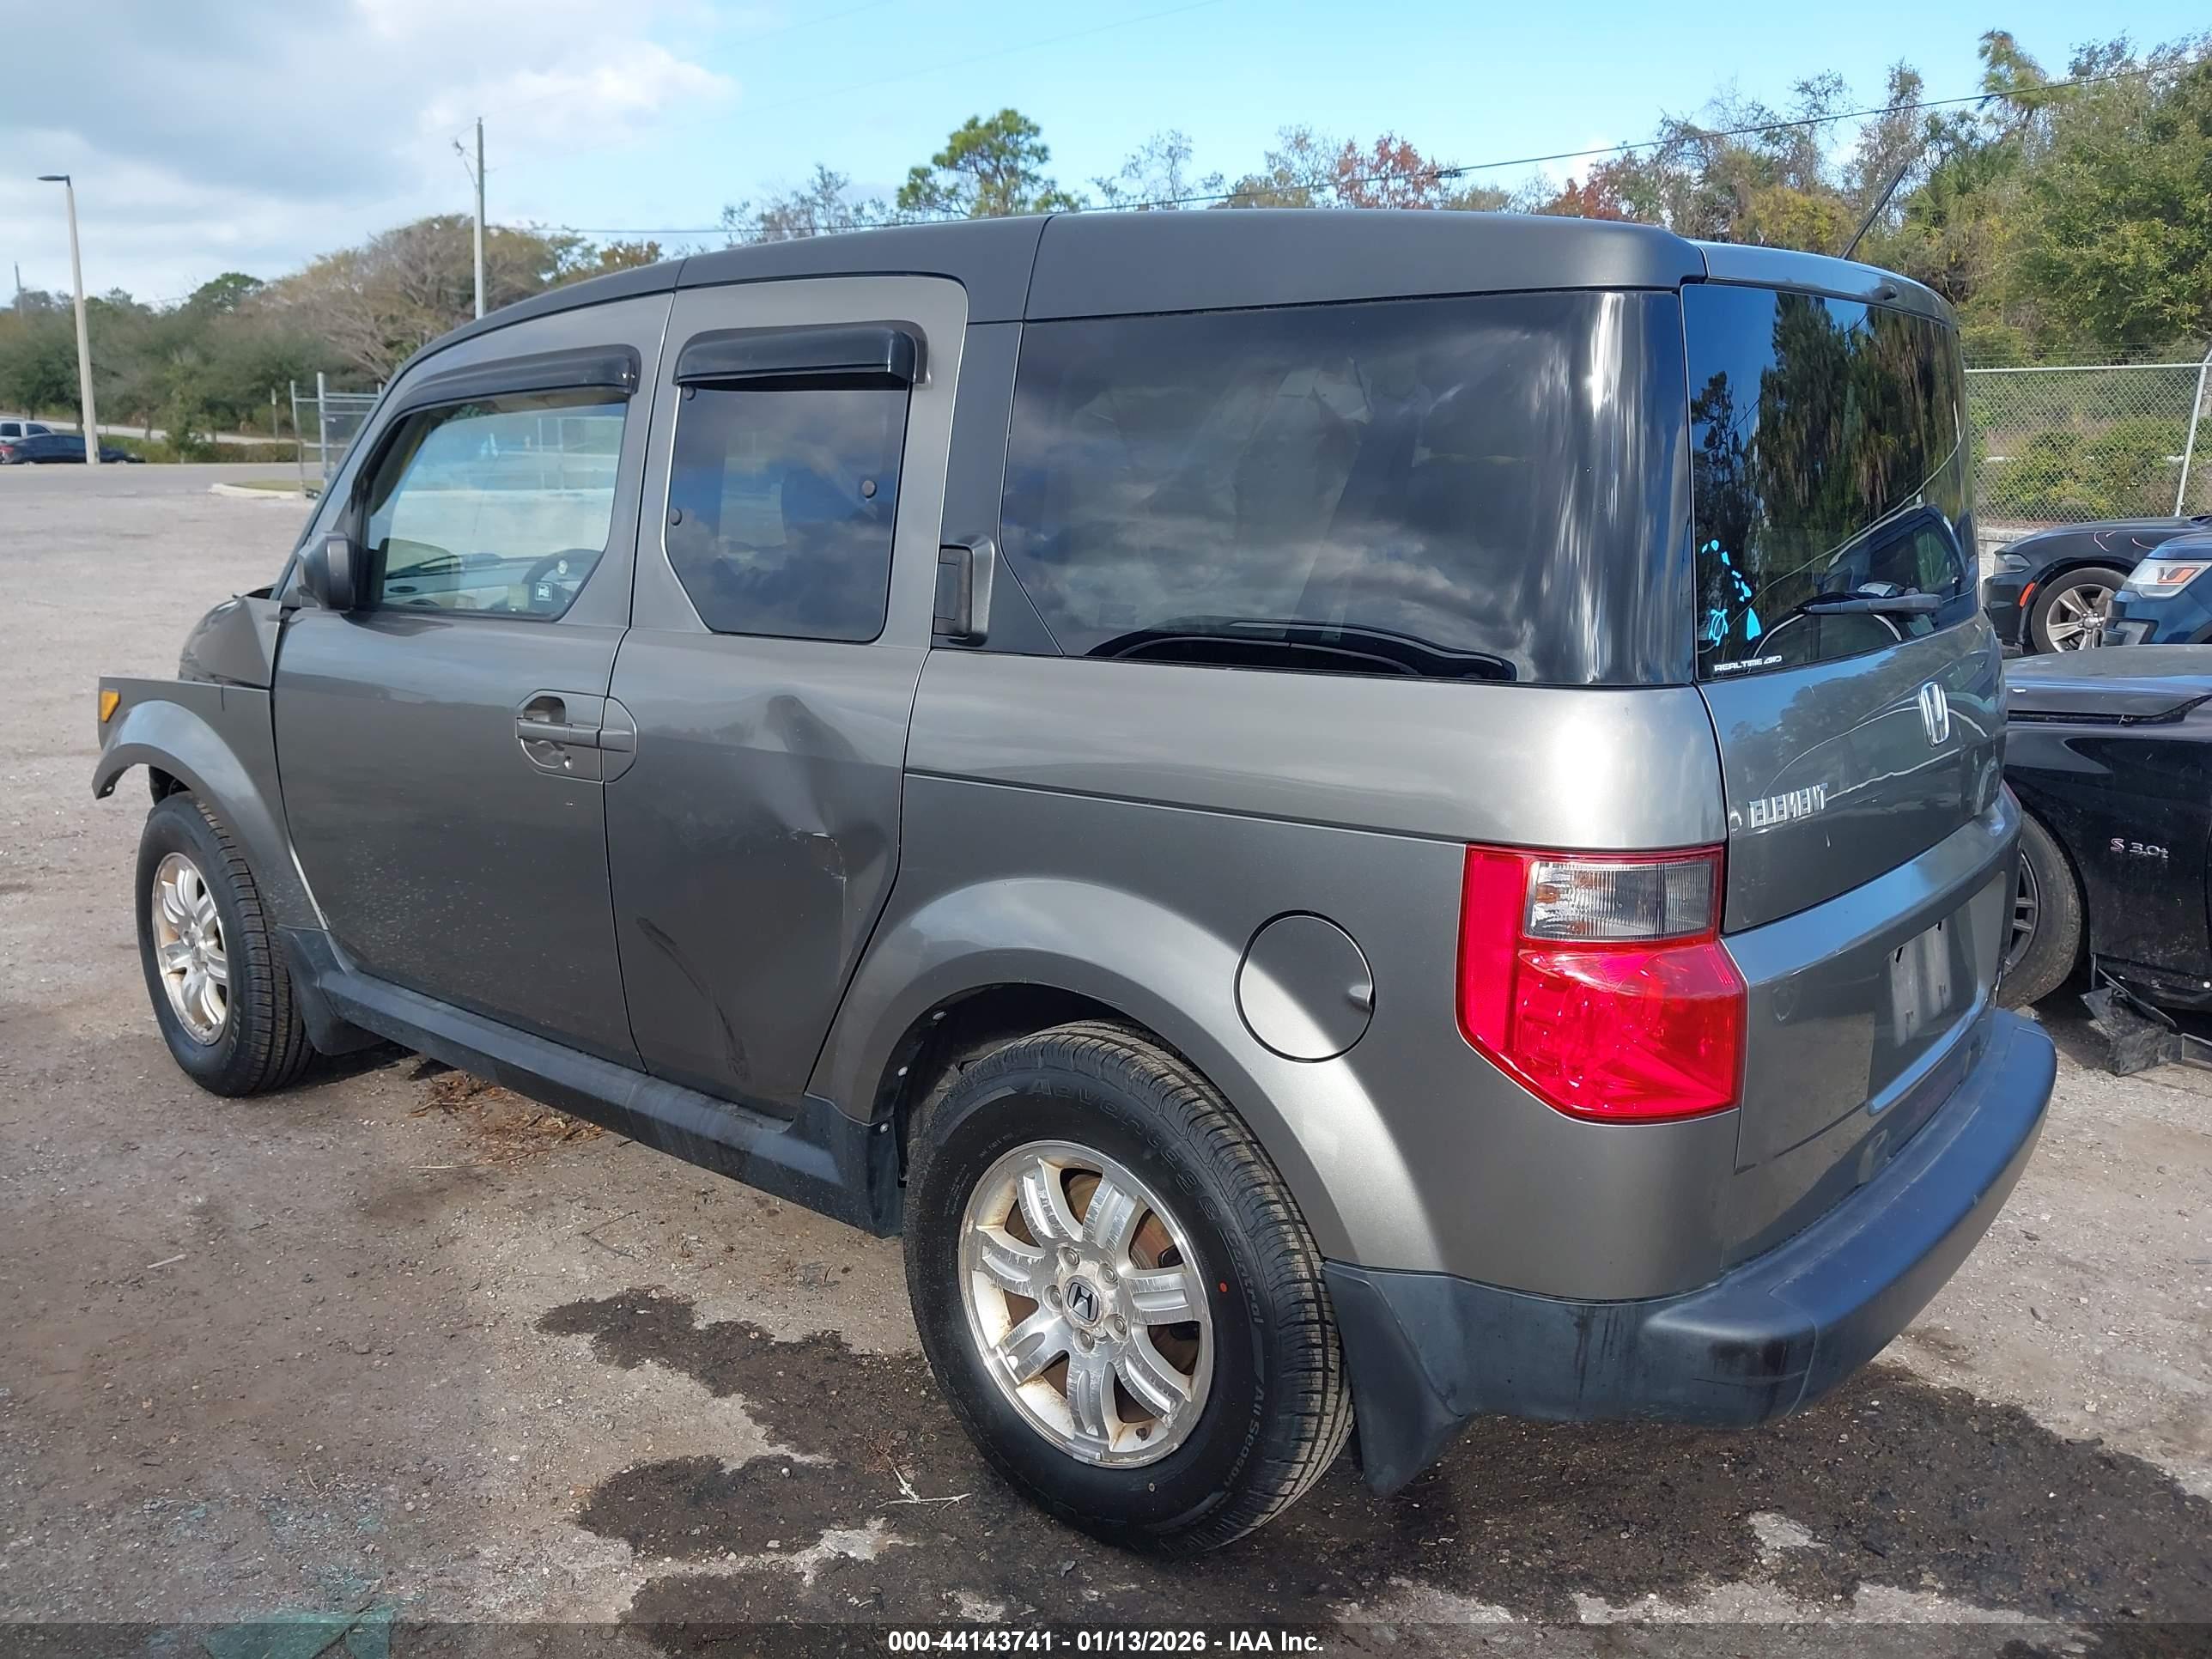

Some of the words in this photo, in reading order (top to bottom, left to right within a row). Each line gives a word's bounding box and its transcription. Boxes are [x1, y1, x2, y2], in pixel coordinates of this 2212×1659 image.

[1714, 657, 1763, 672] REALTIME
[1763, 654, 1783, 665] 4WD
[1747, 782, 1828, 829] ELEMENT
[2110, 837, 2125, 853] S
[1223, 1419, 1260, 1487] Season
